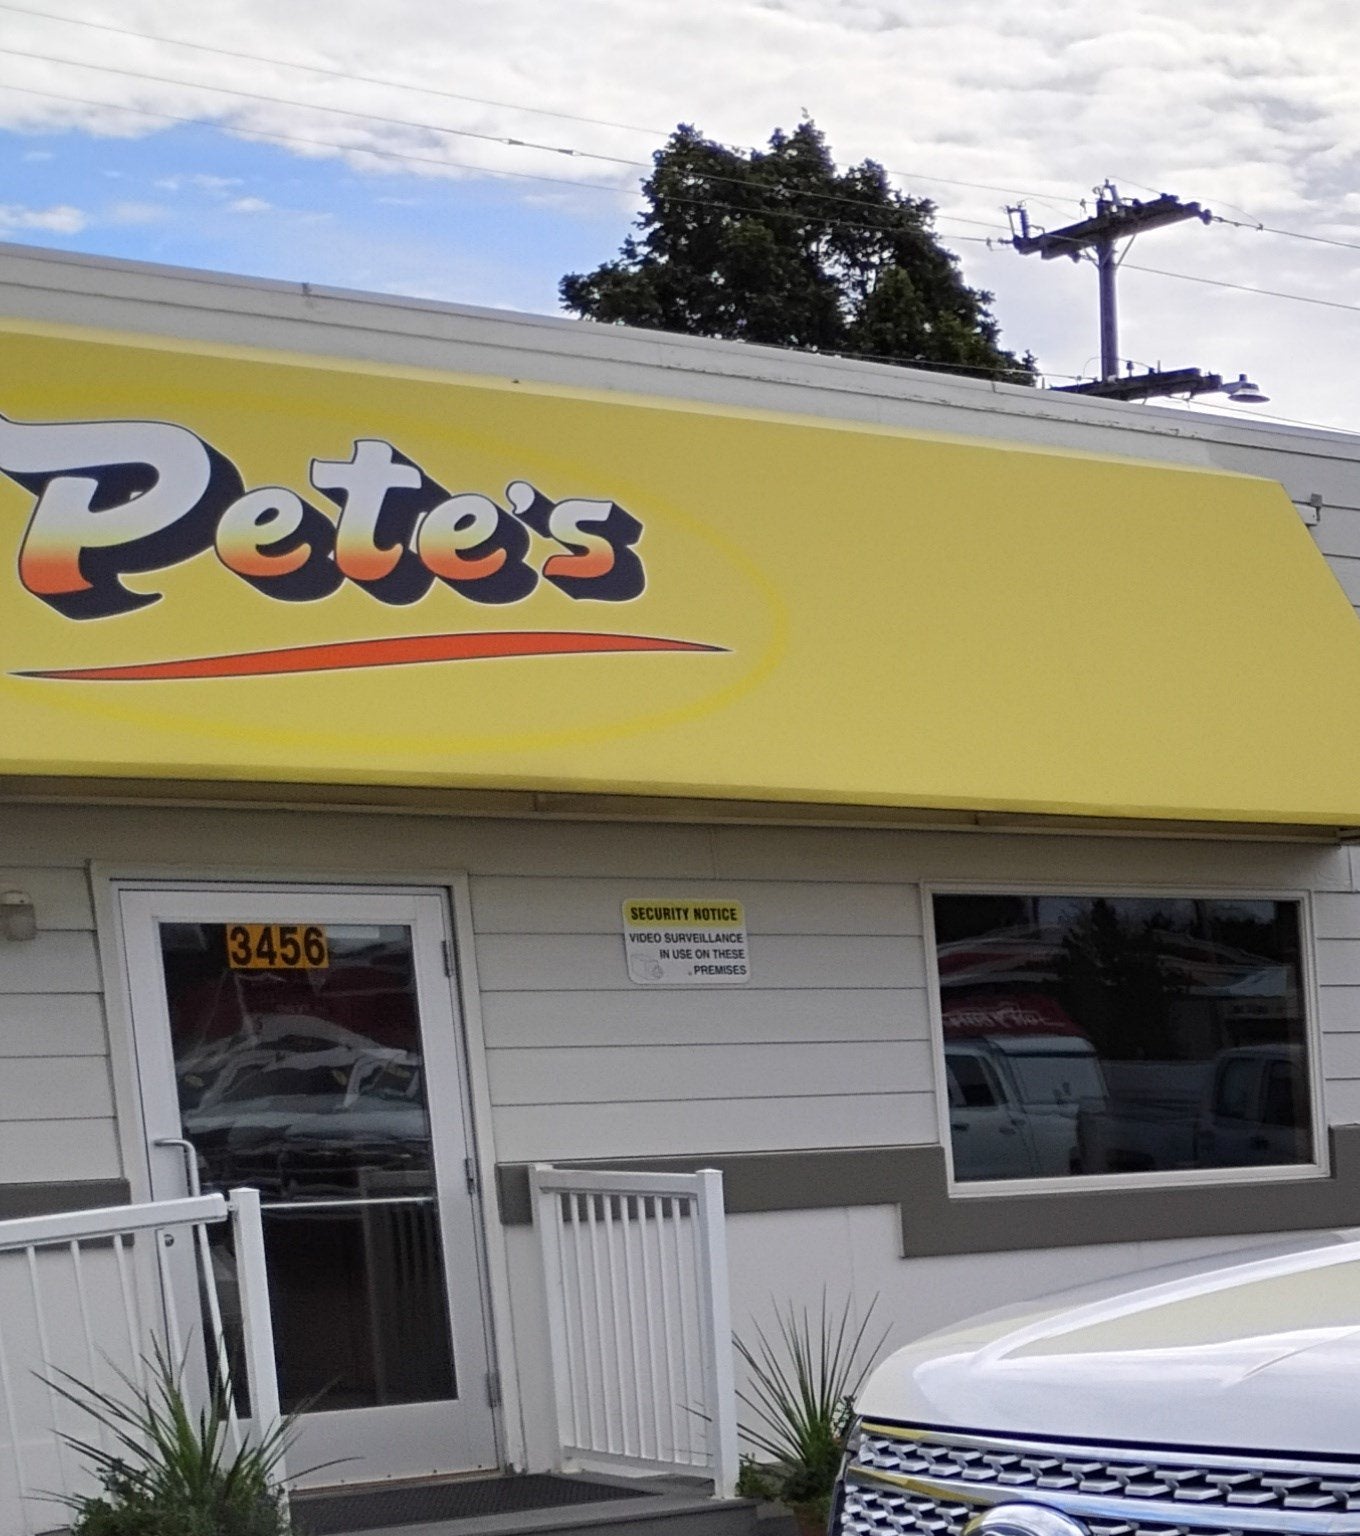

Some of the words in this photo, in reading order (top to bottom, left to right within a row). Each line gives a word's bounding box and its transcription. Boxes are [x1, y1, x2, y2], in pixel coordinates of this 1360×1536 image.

[0, 412, 647, 621] Pete's
[630, 906, 689, 921] SECURITY
[693, 907, 738, 921] NOTICE
[629, 933, 662, 944] VIDEO
[664, 933, 744, 944] SURVEILLANCE
[230, 926, 325, 966] 3456
[659, 949, 670, 959] IN
[672, 949, 693, 960] USE
[695, 950, 710, 959] ON
[713, 950, 746, 960] THESE
[693, 965, 747, 976] PREMISES
